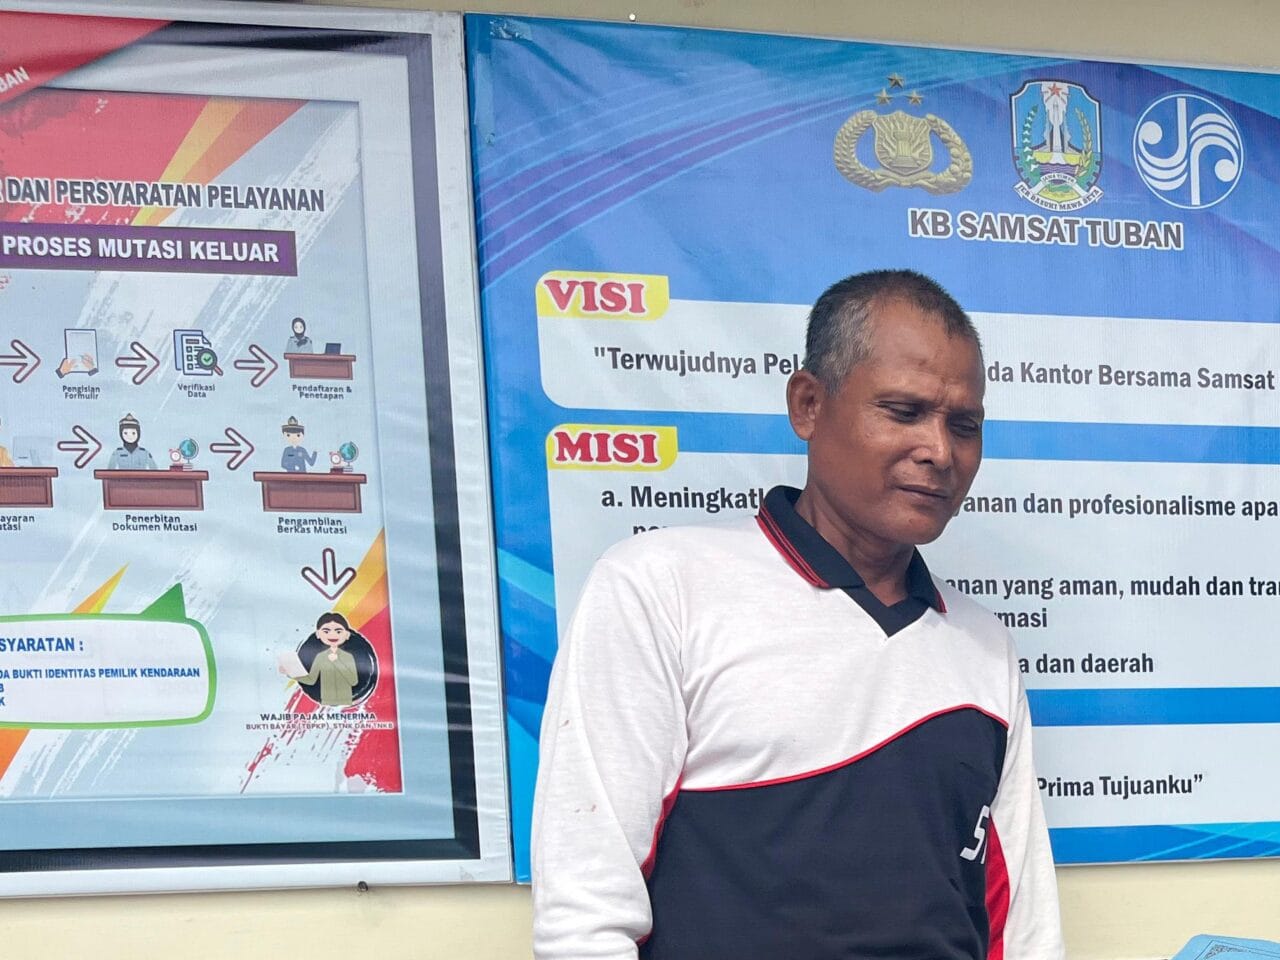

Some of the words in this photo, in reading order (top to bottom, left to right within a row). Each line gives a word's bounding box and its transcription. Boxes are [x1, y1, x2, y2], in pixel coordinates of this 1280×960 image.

[6, 178, 49, 202] DAN
[56, 180, 201, 208] PERSYARATAN
[208, 185, 325, 212] PELAYANAN
[910, 210, 950, 238] KB
[959, 213, 1080, 244] SAMSAT
[1086, 220, 1182, 249] TUBAN
[3, 235, 92, 258] PROSES
[98, 238, 183, 260] MUTASI
[190, 241, 280, 263] KELUAR
[544, 279, 646, 314] VISI
[1020, 362, 1093, 385] Kantor
[1098, 364, 1191, 388] Bersama
[1197, 367, 1275, 391] Samsat
[177, 383, 216, 392] Verifikasi
[292, 384, 344, 393] Pendaftaran
[187, 390, 207, 398] Data
[299, 391, 344, 400] Penetapan
[554, 431, 658, 464] MISI
[601, 489, 623, 508] a.
[1023, 493, 1063, 514] dan
[1069, 493, 1236, 518] profesionalisme
[125, 514, 181, 523] Penerbitan
[278, 516, 342, 527] Pengambilan
[112, 522, 161, 532] Dokumen
[163, 523, 197, 532] Mutasi
[277, 525, 311, 534] Berkas
[313, 525, 347, 535] Mutasi
[1002, 577, 1054, 600] yang
[1059, 579, 1124, 600] aman,
[1130, 576, 1200, 596] mudah
[1206, 576, 1244, 596] dan
[1035, 653, 1075, 674] dan
[1081, 653, 1154, 674] daerah
[13, 668, 42, 679] BUKTI
[45, 668, 96, 678] IDENTITAS
[99, 668, 138, 678] PEMILIK
[140, 667, 200, 678] KENDARAAN
[260, 713, 291, 721] WAJIB
[293, 713, 324, 721] PAJAK
[326, 713, 376, 721] MENERIMA
